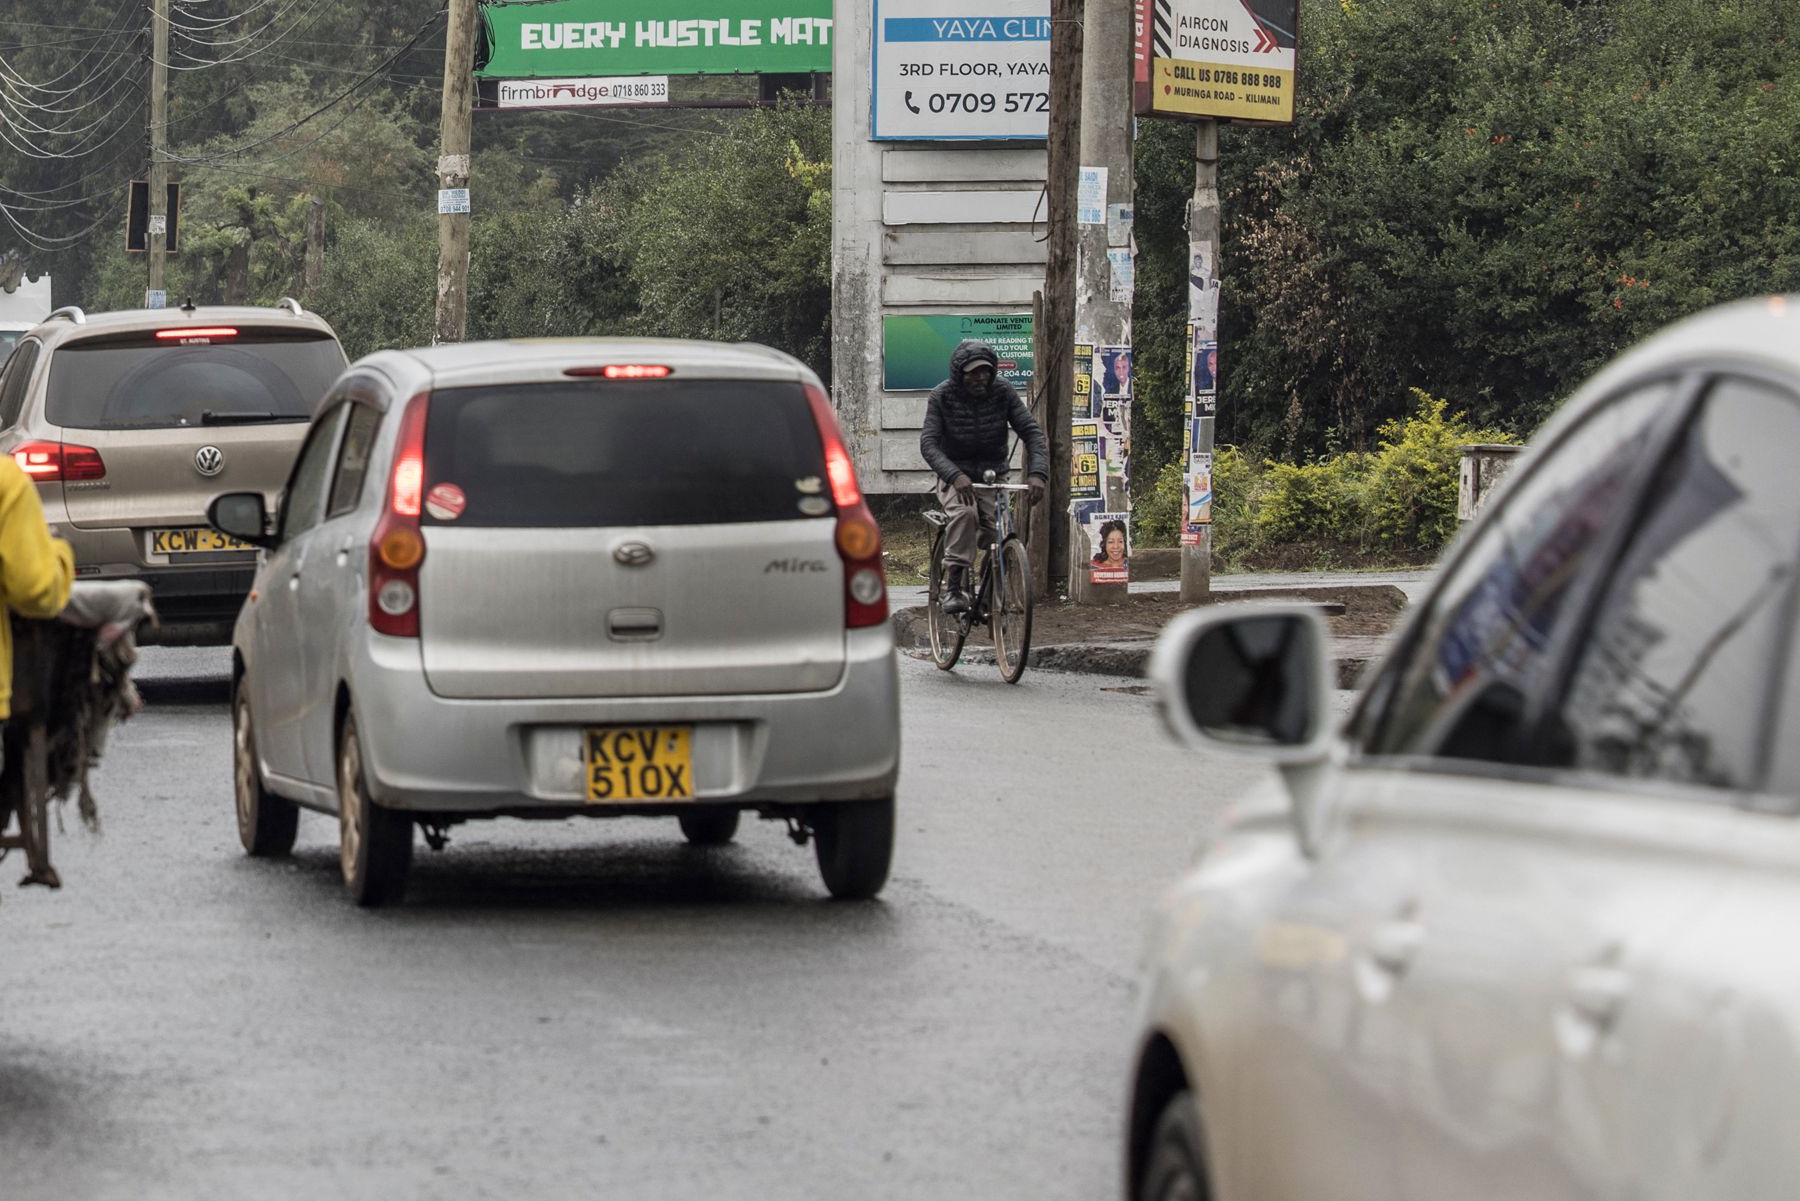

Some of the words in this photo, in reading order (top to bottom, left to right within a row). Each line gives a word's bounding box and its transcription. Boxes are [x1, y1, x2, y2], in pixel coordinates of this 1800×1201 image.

[635, 18, 761, 47] HUSTLE
[932, 19, 997, 39] YAYA
[1179, 15, 1228, 32] AIRCON
[1179, 34, 1250, 54] DIAGNOSIS
[899, 63, 934, 76] 3RD
[939, 63, 1002, 78] FLOOR,
[1007, 62, 1050, 75] YAYA
[1174, 65, 1196, 81] CALL
[1199, 68, 1211, 82] US
[1213, 69, 1238, 85] 0786
[1241, 72, 1260, 87] 888
[1262, 74, 1281, 89] 988
[612, 84, 633, 98] 0718
[634, 84, 649, 97] 860
[650, 83, 666, 96] 333
[1174, 86, 1211, 99] MURINGA
[1213, 88, 1235, 101] ROAD
[1245, 93, 1280, 105] KILIMANI
[929, 93, 996, 113] 0709
[1004, 92, 1050, 113] 572
[1076, 380, 1084, 392] 6
[1081, 460, 1090, 472] 6
[152, 531, 198, 551] KCW
[764, 557, 828, 574] Mira
[589, 731, 659, 764] KCV
[592, 765, 686, 799] 510X
